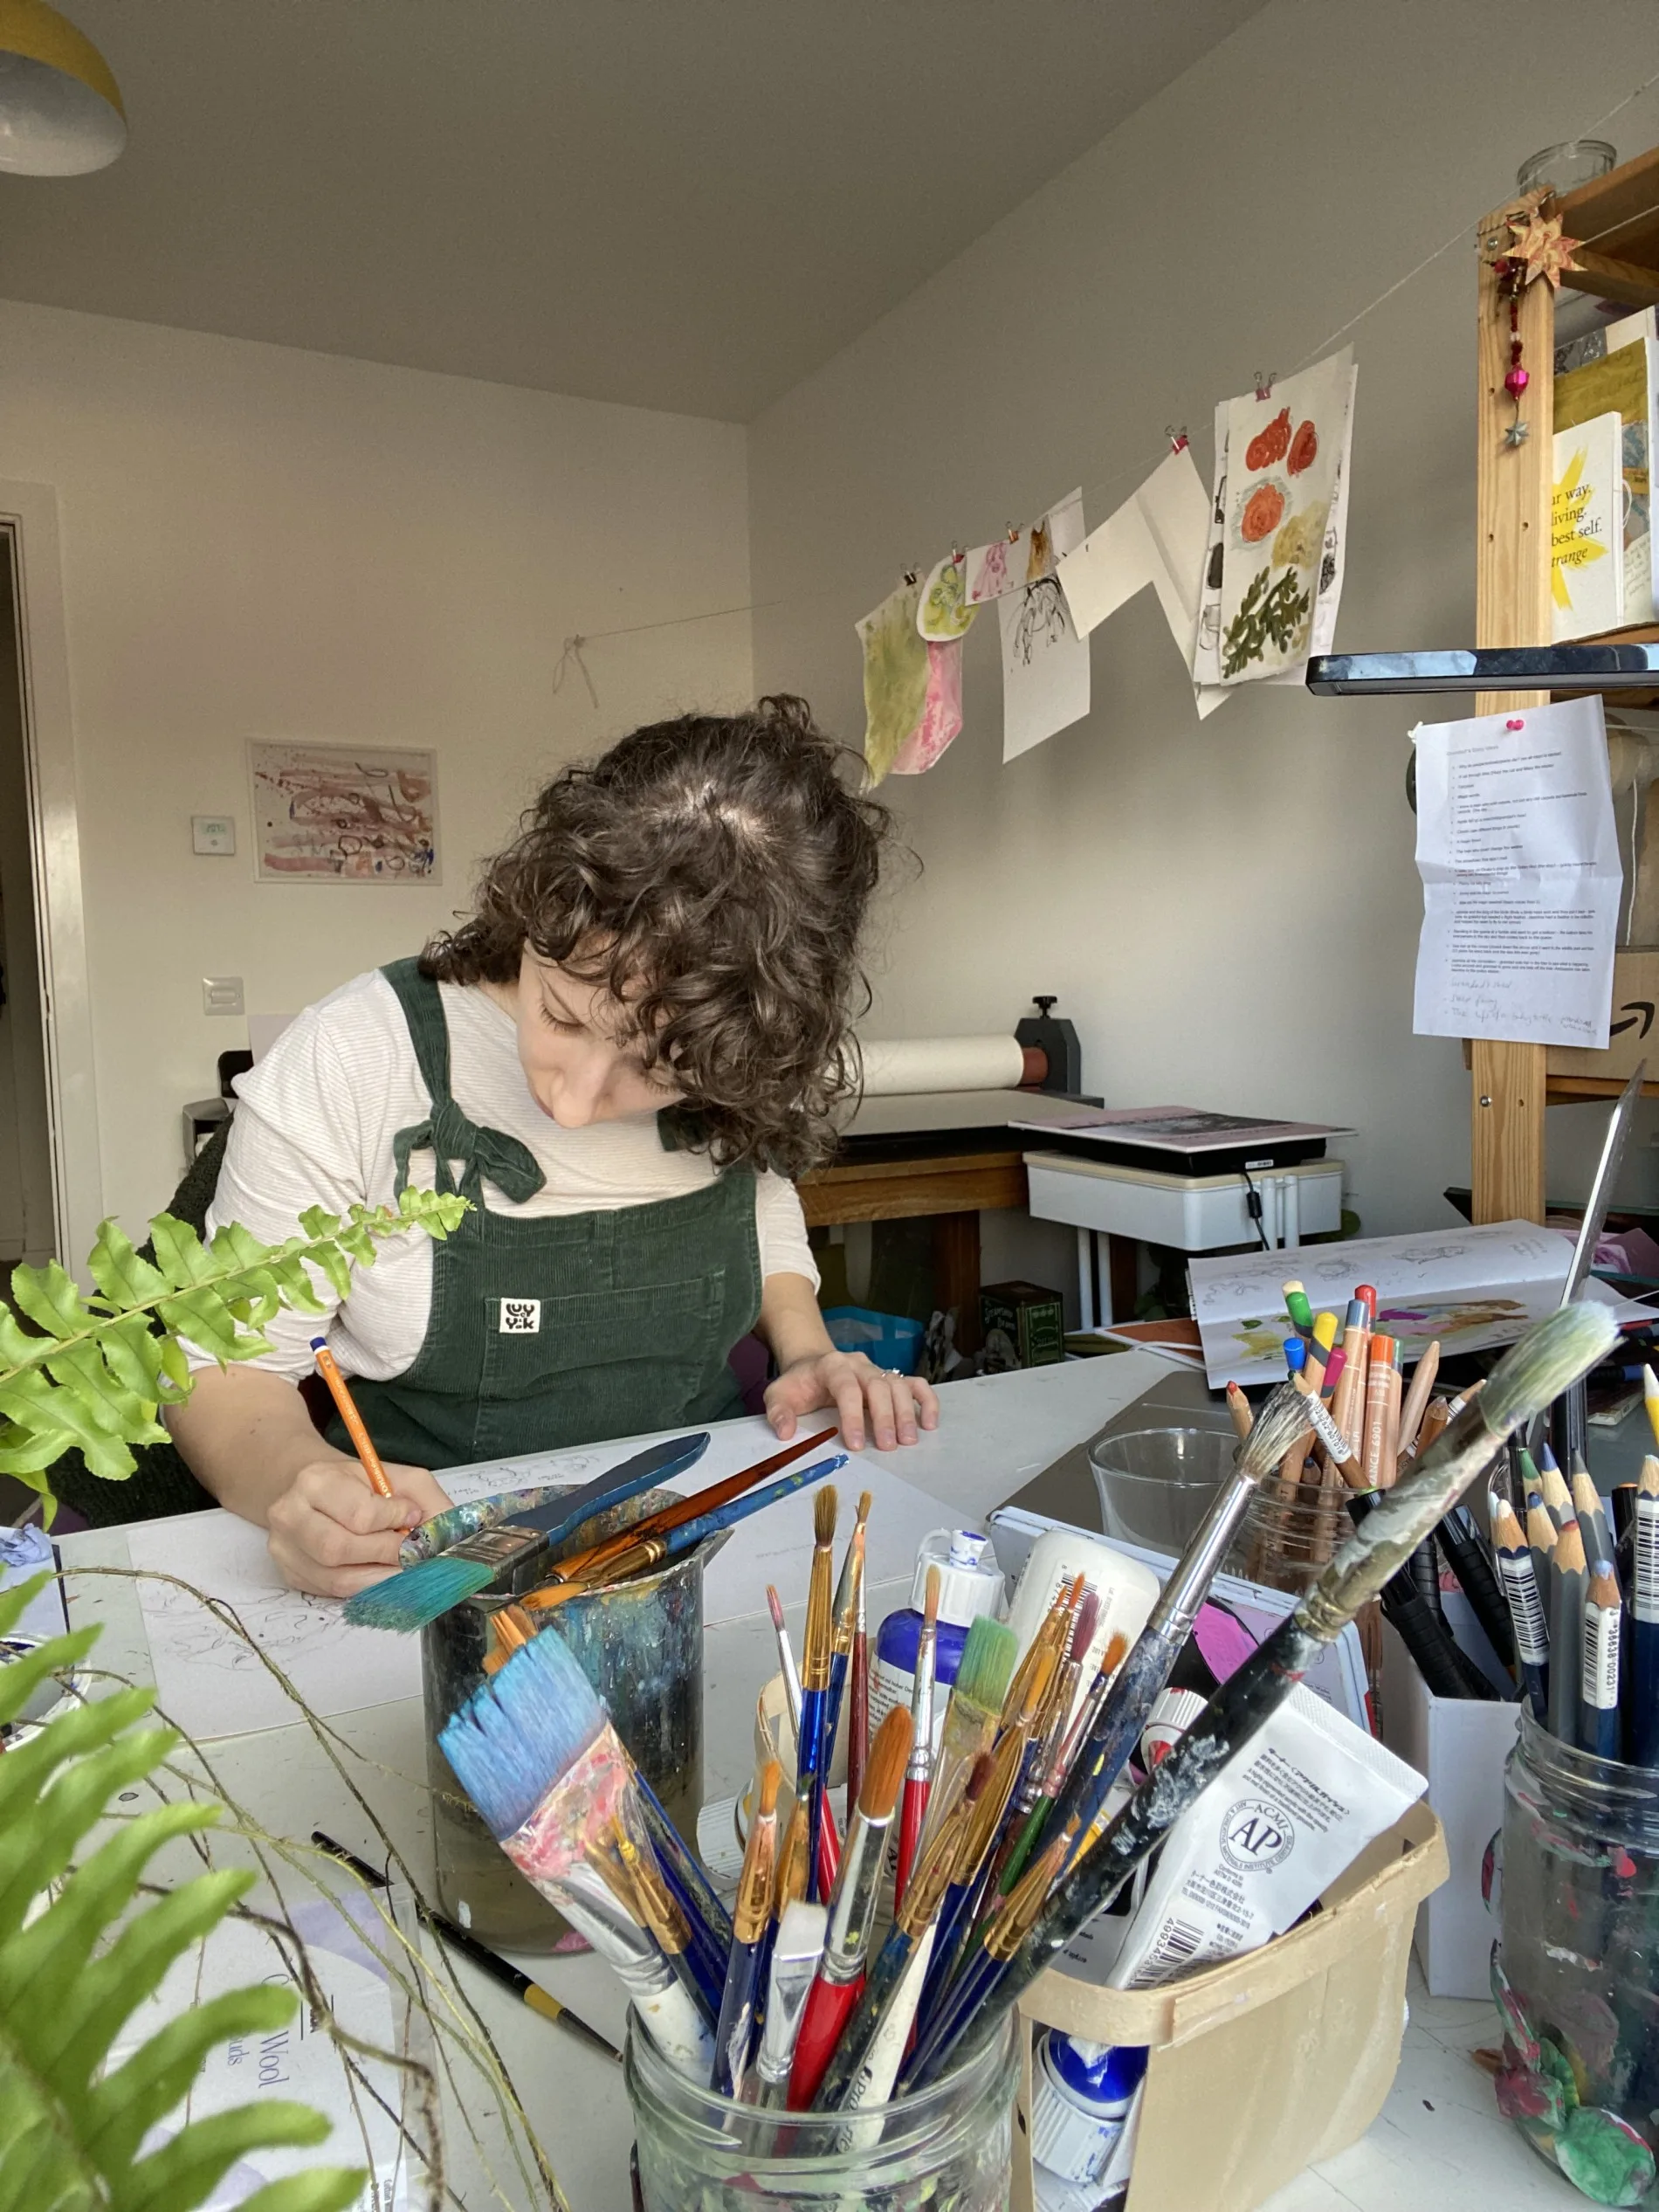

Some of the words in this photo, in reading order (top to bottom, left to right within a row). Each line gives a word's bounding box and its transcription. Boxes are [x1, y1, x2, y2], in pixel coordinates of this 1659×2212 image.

[1566, 484, 1591, 500] way.
[1552, 506, 1587, 526] living.
[1552, 531, 1575, 547] best
[1579, 516, 1602, 538] self.
[1552, 548, 1588, 568] trange
[1373, 1422, 1382, 1447] 6901
[1253, 1803, 1289, 1830] ACMI
[1229, 1817, 1283, 1856] AP
[1275, 1835, 1293, 1863] CERTIFIED
[1191, 1871, 1245, 1905] ターナー色彩株式会社
[228, 2031, 250, 2066] uds
[258, 2030, 290, 2089] Wool
